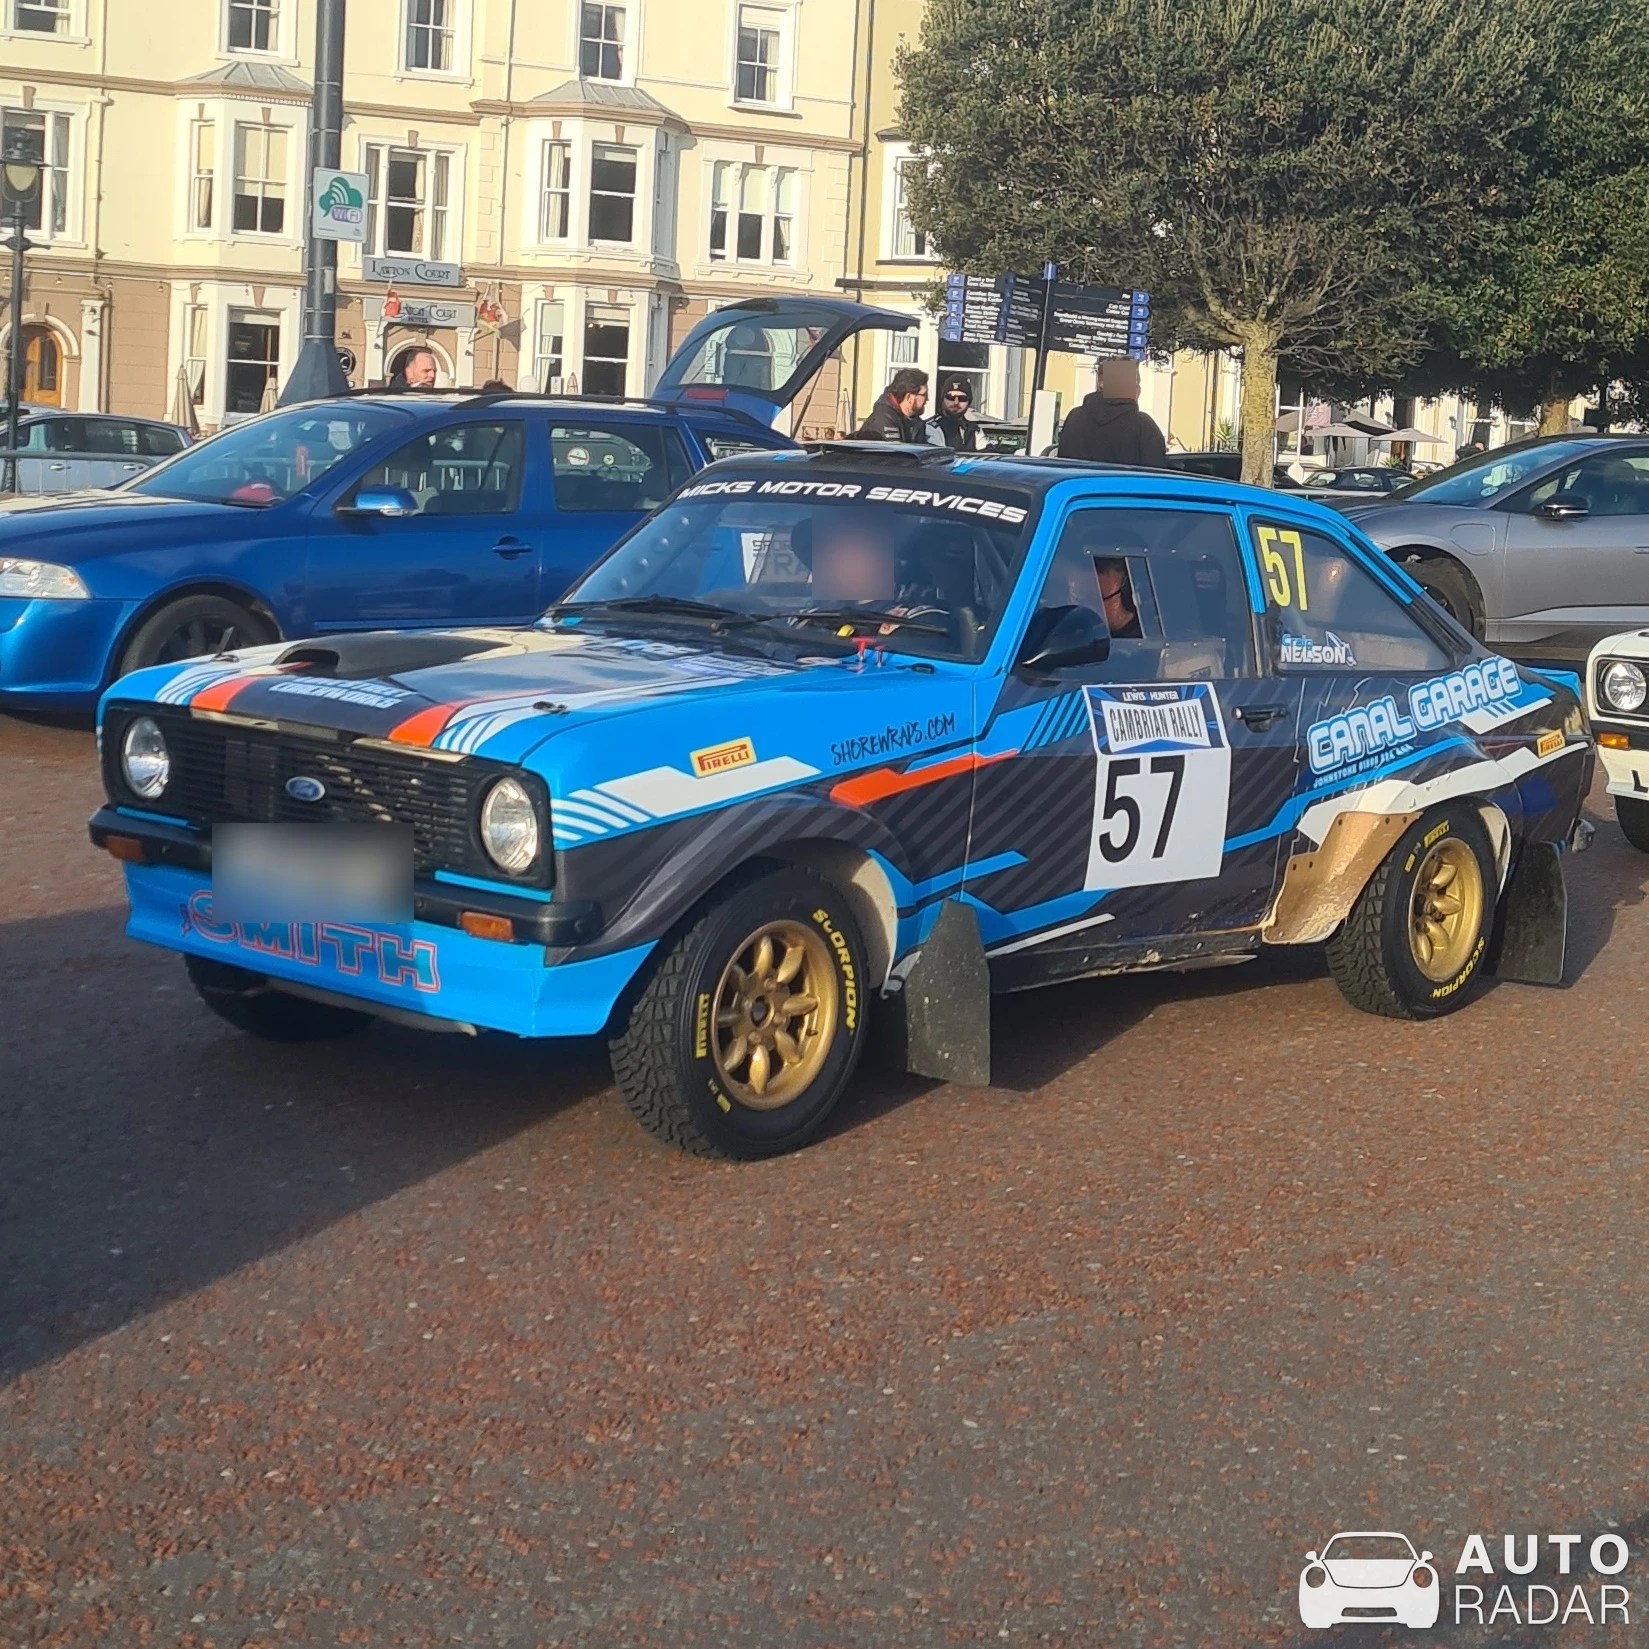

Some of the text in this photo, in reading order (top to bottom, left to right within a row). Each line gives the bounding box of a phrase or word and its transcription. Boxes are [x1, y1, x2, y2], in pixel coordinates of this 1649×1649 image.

[678, 480, 1028, 524] MICKS MOTOR SERVICES
[1257, 526, 1308, 611] 57
[1281, 644, 1347, 664] NELSON
[1122, 689, 1180, 702] LEWIS HUNTER
[1308, 656, 1521, 773] CANAL GARAGE
[830, 712, 956, 766] SHOREWRAPS.COM
[1109, 705, 1203, 742] CAMBRIAN RALLY
[1540, 734, 1564, 754] PIRELLI
[698, 743, 750, 771] PIRELLI
[1099, 754, 1186, 863] 57
[812, 908, 858, 1032] SCORPION
[1432, 936, 1485, 999] SCORPION
